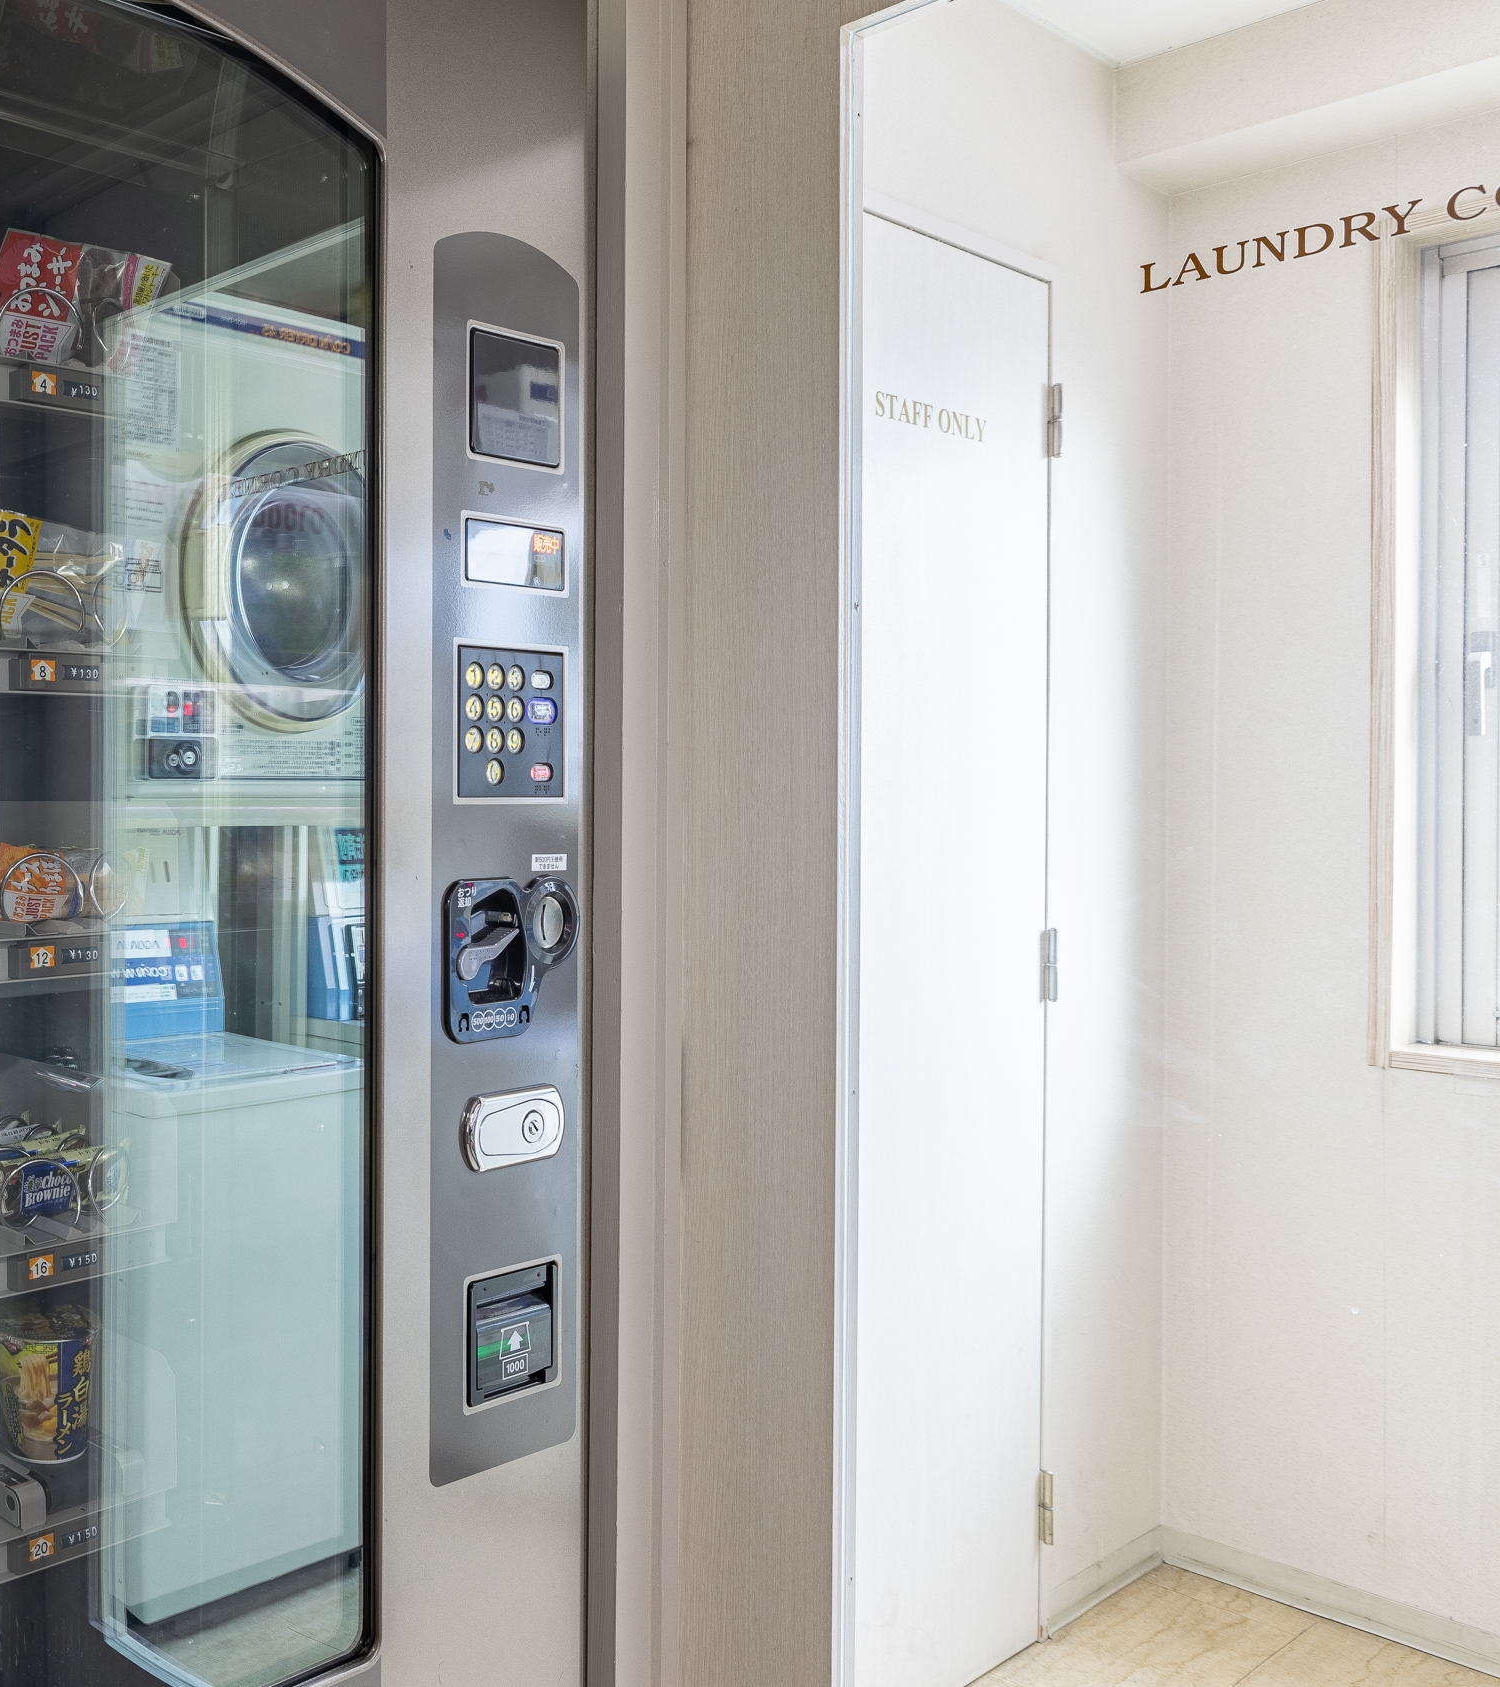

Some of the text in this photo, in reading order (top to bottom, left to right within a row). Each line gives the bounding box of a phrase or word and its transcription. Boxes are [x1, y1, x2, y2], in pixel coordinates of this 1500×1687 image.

[1139, 197, 1424, 295] LAUNDRY
[33, 324, 59, 360] PACK
[40, 378, 48, 390] 4
[71, 385, 98, 397] ¥130
[874, 389, 988, 443] STAFF ONLY
[532, 533, 560, 555] 販売中
[39, 665, 46, 678] 8
[70, 667, 99, 679] ¥130
[491, 668, 500, 686] 2
[511, 670, 519, 688] 3
[469, 698, 479, 717] 4
[490, 699, 499, 718] 5
[511, 700, 519, 719] 6
[490, 731, 499, 750] 8
[511, 732, 519, 750] 9
[490, 762, 499, 782] 0
[11, 860, 41, 893] チーズ
[457, 886, 477, 898] おつり
[25, 896, 42, 919] JUST
[40, 897, 57, 920] PACK
[457, 897, 472, 908] 返却
[35, 952, 49, 965] 12
[69, 950, 99, 961] ¥130
[473, 1016, 484, 1026] 500
[495, 1013, 505, 1023] 50
[506, 1012, 515, 1022] 10
[24, 1184, 71, 1208] Brownie
[34, 1261, 48, 1276] 16
[69, 1252, 98, 1267] ¥150
[505, 1358, 526, 1374] 1000
[71, 1350, 91, 1430] 鶏白湯
[57, 1392, 73, 1455] ラーメン
[68, 1526, 98, 1546] ¥150
[34, 1541, 48, 1556] 20
